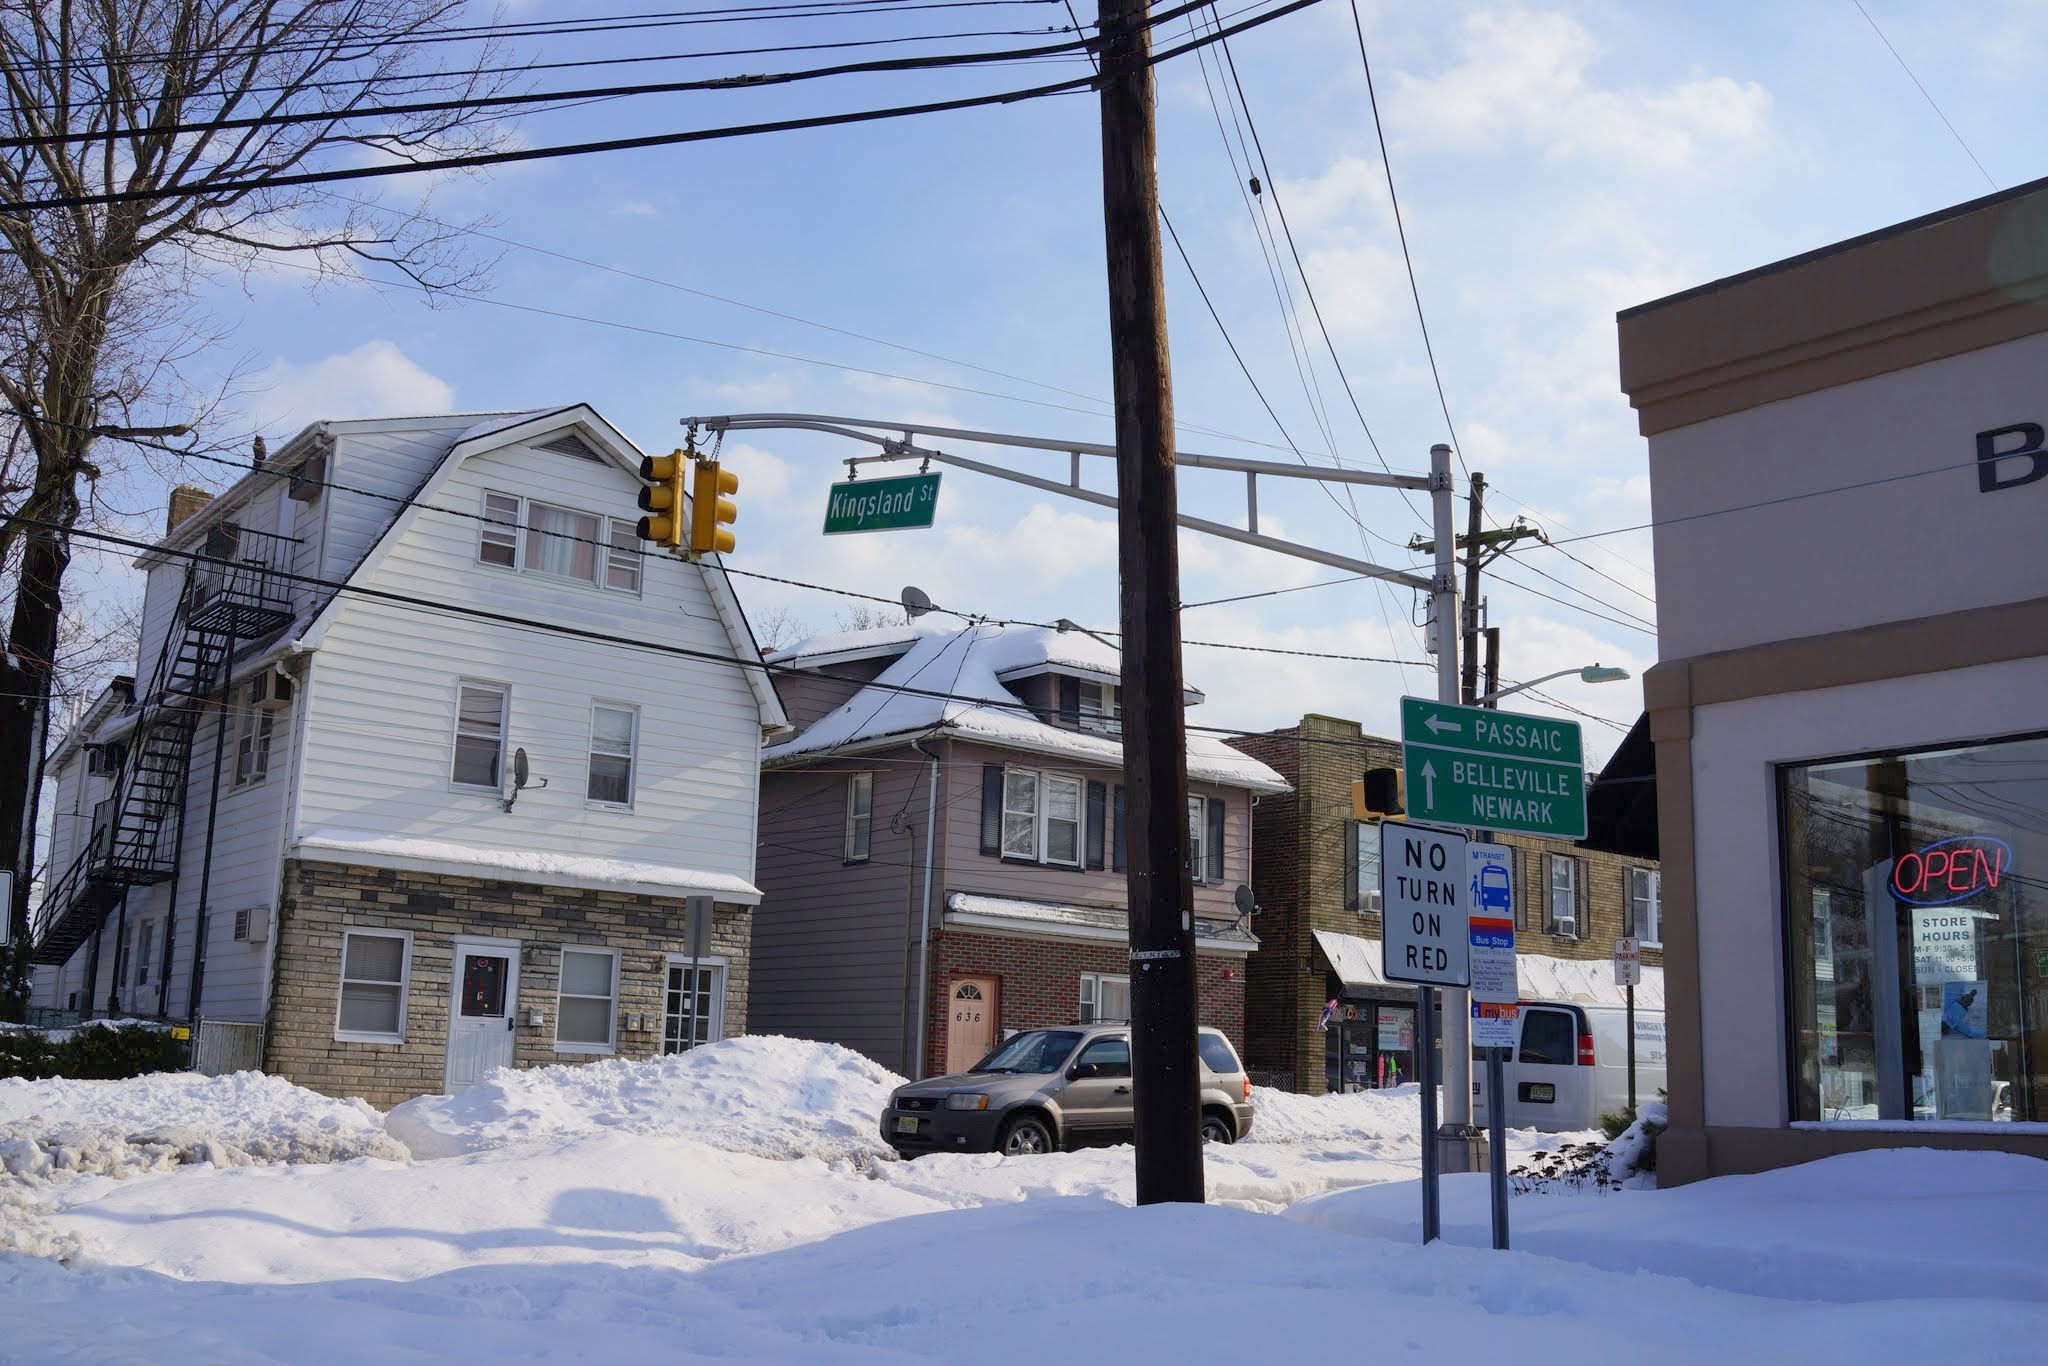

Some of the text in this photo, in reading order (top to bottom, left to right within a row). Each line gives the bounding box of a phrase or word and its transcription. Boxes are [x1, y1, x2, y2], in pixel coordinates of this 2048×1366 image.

[830, 484, 934, 525] Kingsland St
[1475, 719, 1562, 752] PASSAIC
[1452, 760, 1570, 797] BELLEVILLE
[1472, 794, 1553, 825] NEWARK
[1405, 838, 1446, 872] NO
[1479, 851, 1505, 861] TRANSIT
[1894, 847, 2001, 893] OPEN
[1396, 876, 1455, 907] TURN
[1412, 911, 1441, 938] ON
[1922, 916, 1967, 928] STORE
[1475, 935, 1509, 948] Bus Stop
[1922, 931, 1970, 942] HOURS
[1622, 942, 1631, 951] NO
[1914, 945, 1931, 953] M-F
[1934, 944, 1952, 953] 9:30
[1961, 944, 1974, 952] 5:3
[1406, 944, 1448, 971] RED
[1615, 952, 1639, 961] PARKING
[1914, 955, 1931, 964] SAT
[1935, 955, 1955, 963] 11:00
[1962, 954, 1975, 962] 5:0
[1622, 963, 1631, 971] ANY
[1915, 966, 1934, 974] SUN
[956, 1012, 980, 1023] 636
[1635, 1021, 1663, 1032] VINCENT
[1634, 1033, 1662, 1042] umbing
